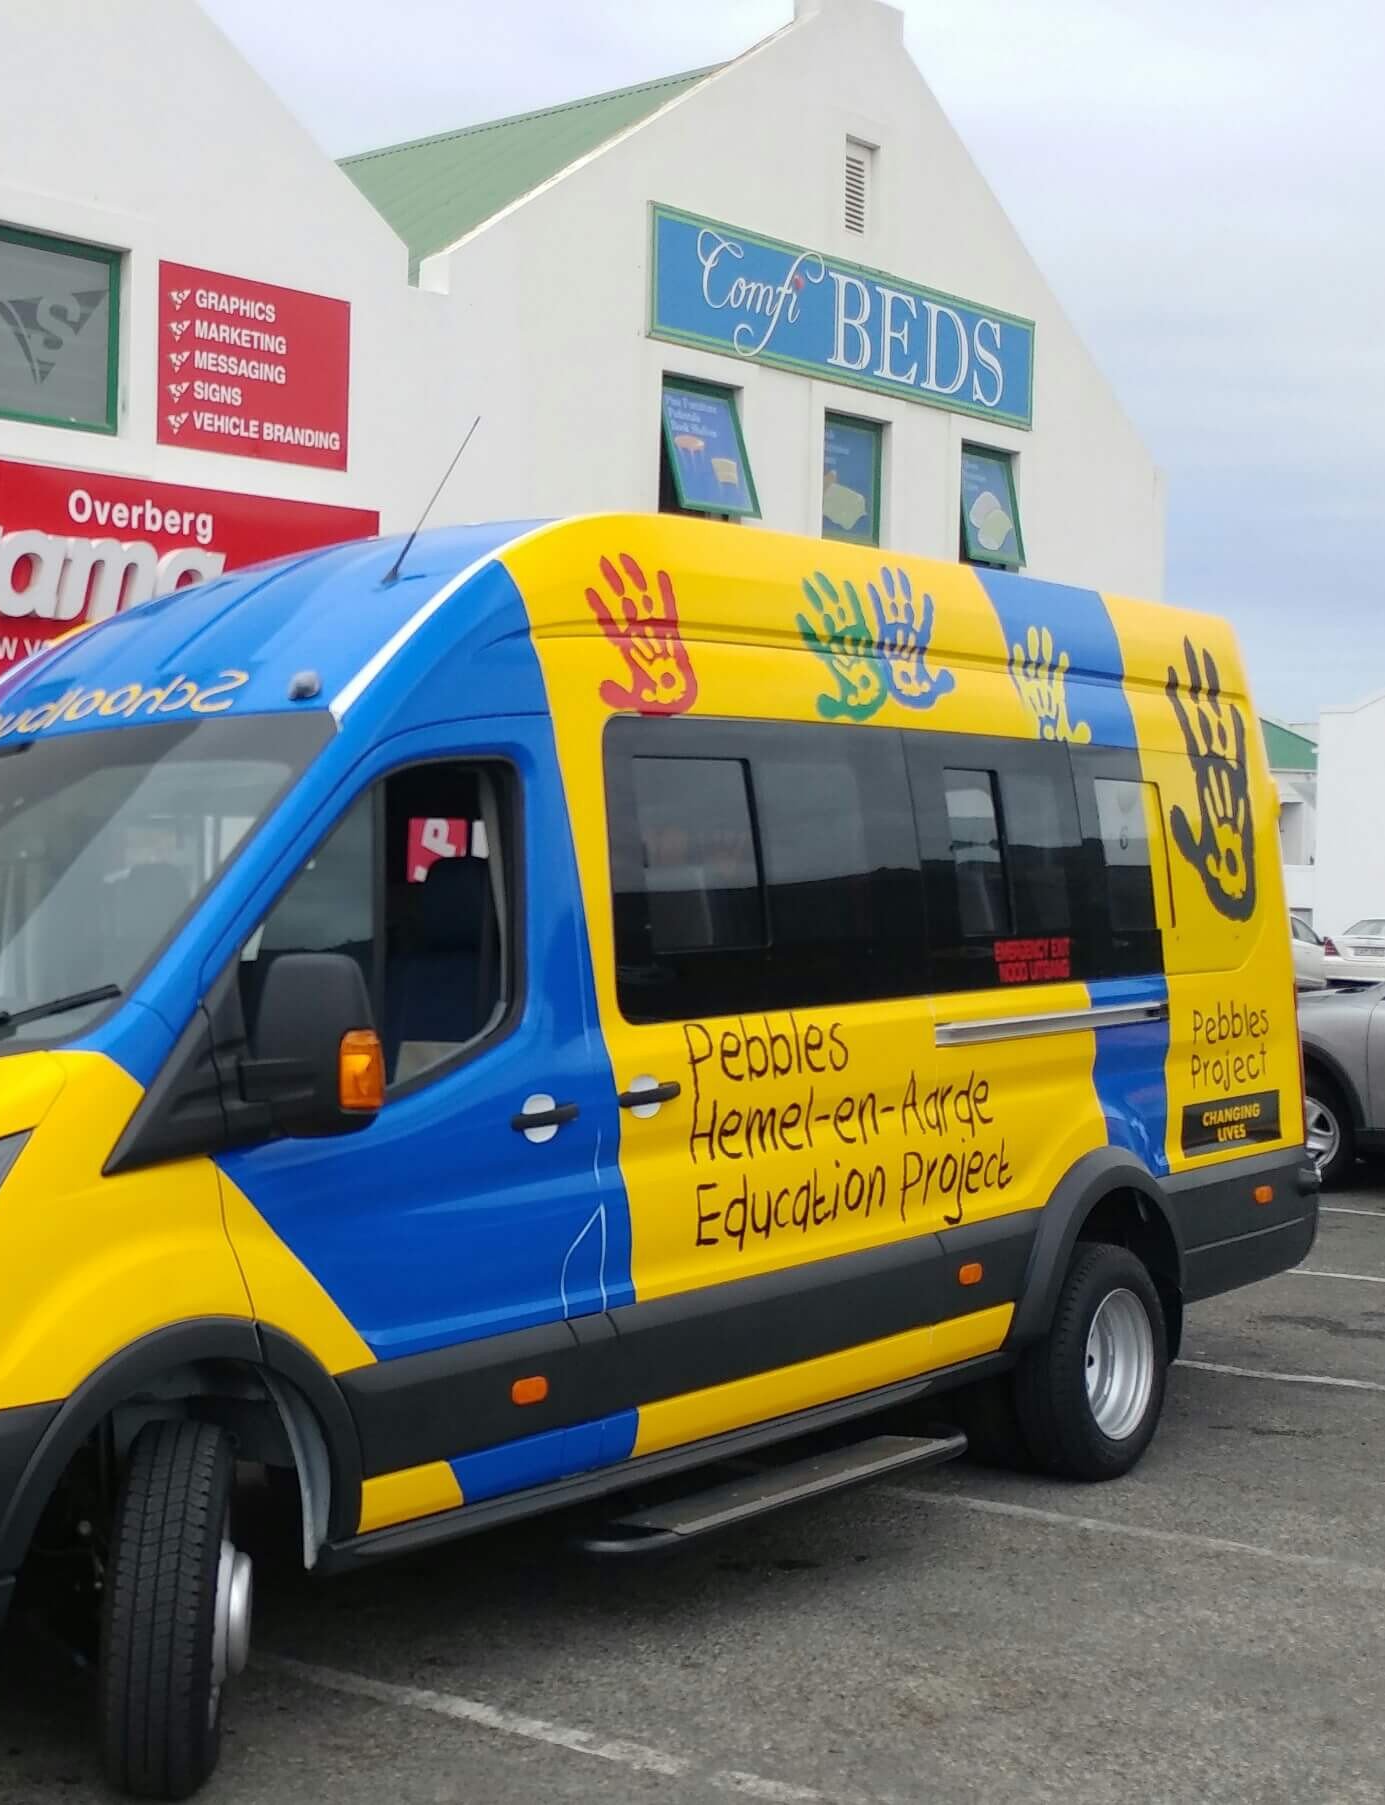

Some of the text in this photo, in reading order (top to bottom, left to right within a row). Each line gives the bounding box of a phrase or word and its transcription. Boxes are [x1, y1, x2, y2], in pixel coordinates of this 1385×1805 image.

[195, 289, 276, 323] GRAPHICS
[696, 228, 1004, 408] Comfi BEDS
[194, 319, 287, 355] MARKETING
[194, 350, 286, 384] MESSAGING
[193, 380, 242, 406] SIGNS
[193, 411, 340, 450] VEHICLE BRANDING
[67, 489, 214, 545] Overberg
[1192, 1000, 1270, 1045] Pebbles
[683, 1010, 850, 1095] Pebbles
[1191, 1043, 1268, 1091] Project
[689, 1069, 994, 1165] Hemel-en-Aarde
[1202, 1103, 1261, 1127] CHANGING
[1217, 1123, 1247, 1142] LIVES
[695, 1137, 1014, 1252] Education Project
